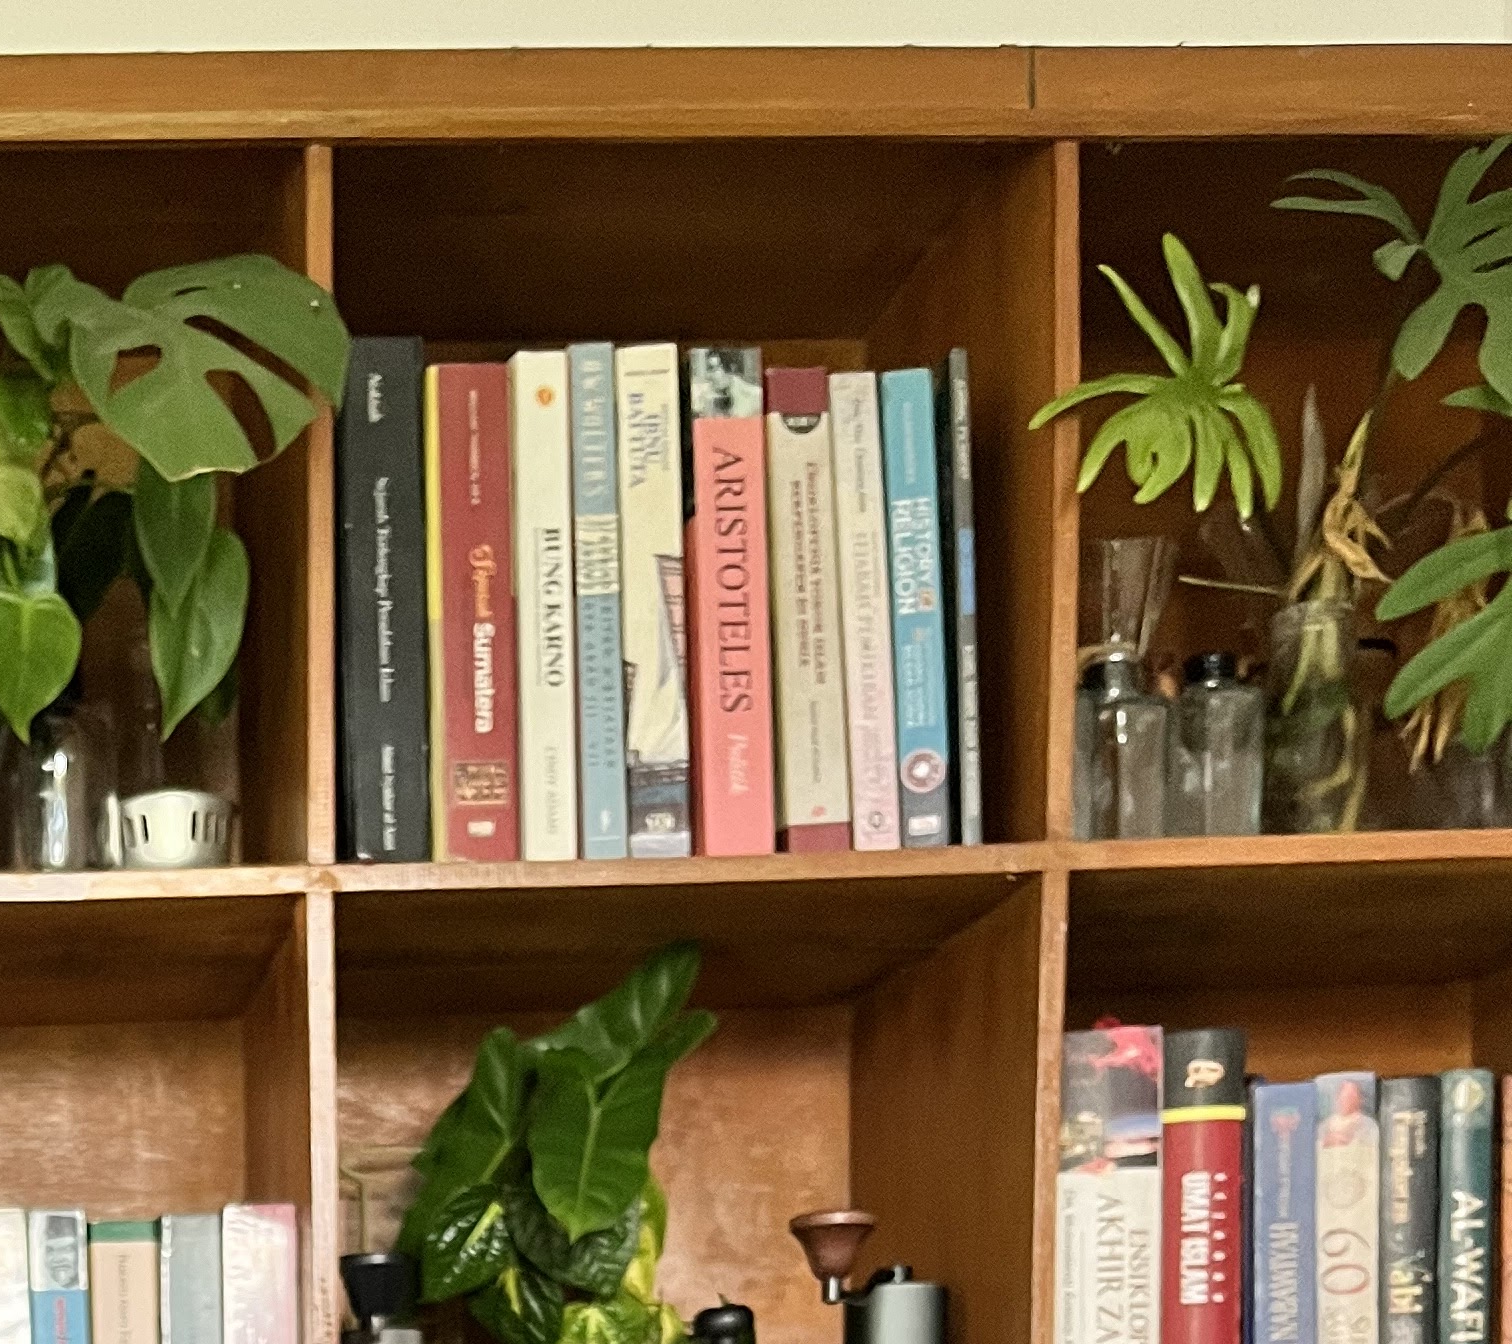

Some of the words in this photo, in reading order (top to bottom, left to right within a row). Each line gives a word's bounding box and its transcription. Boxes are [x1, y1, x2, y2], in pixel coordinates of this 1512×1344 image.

[542, 527, 565, 597] BUNG
[709, 445, 753, 714] ARISTOTELES
[891, 498, 918, 616] RELIGION
[911, 497, 934, 586] HISTORY
[544, 602, 567, 688] KARNO
[1095, 1192, 1126, 1297] AKHIR
[1180, 1170, 1212, 1234] UMAT
[1179, 1235, 1211, 1306] ISLAM
[1320, 1227, 1373, 1296] 60
[1448, 1189, 1486, 1343] AL-WAFI
